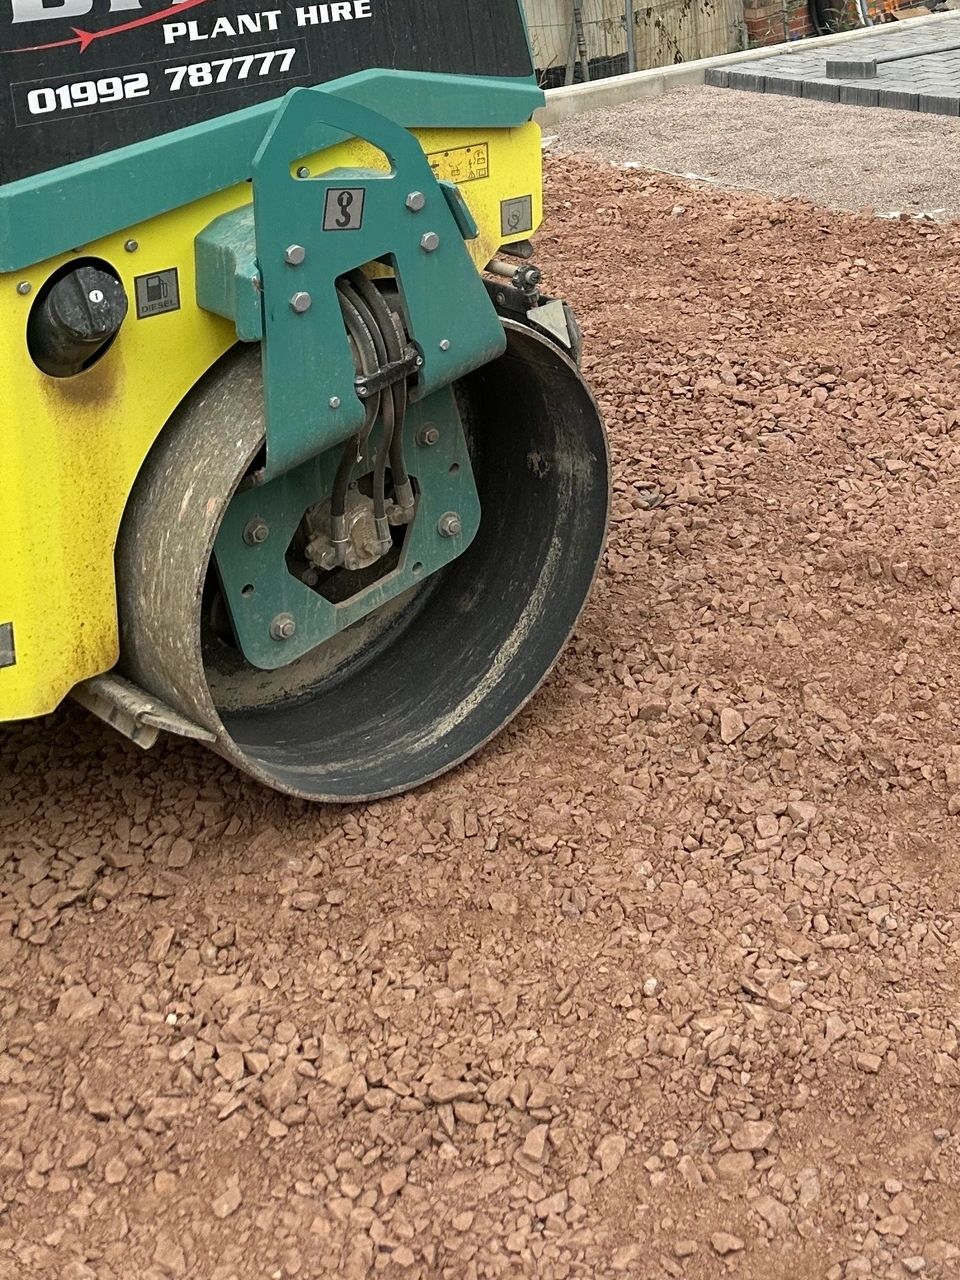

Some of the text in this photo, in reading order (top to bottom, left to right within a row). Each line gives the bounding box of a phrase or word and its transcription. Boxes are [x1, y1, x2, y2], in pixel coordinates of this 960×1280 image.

[163, 10, 282, 44] PLANT
[27, 48, 296, 115] 01992 787777
[141, 300, 177, 313] DIESEL
